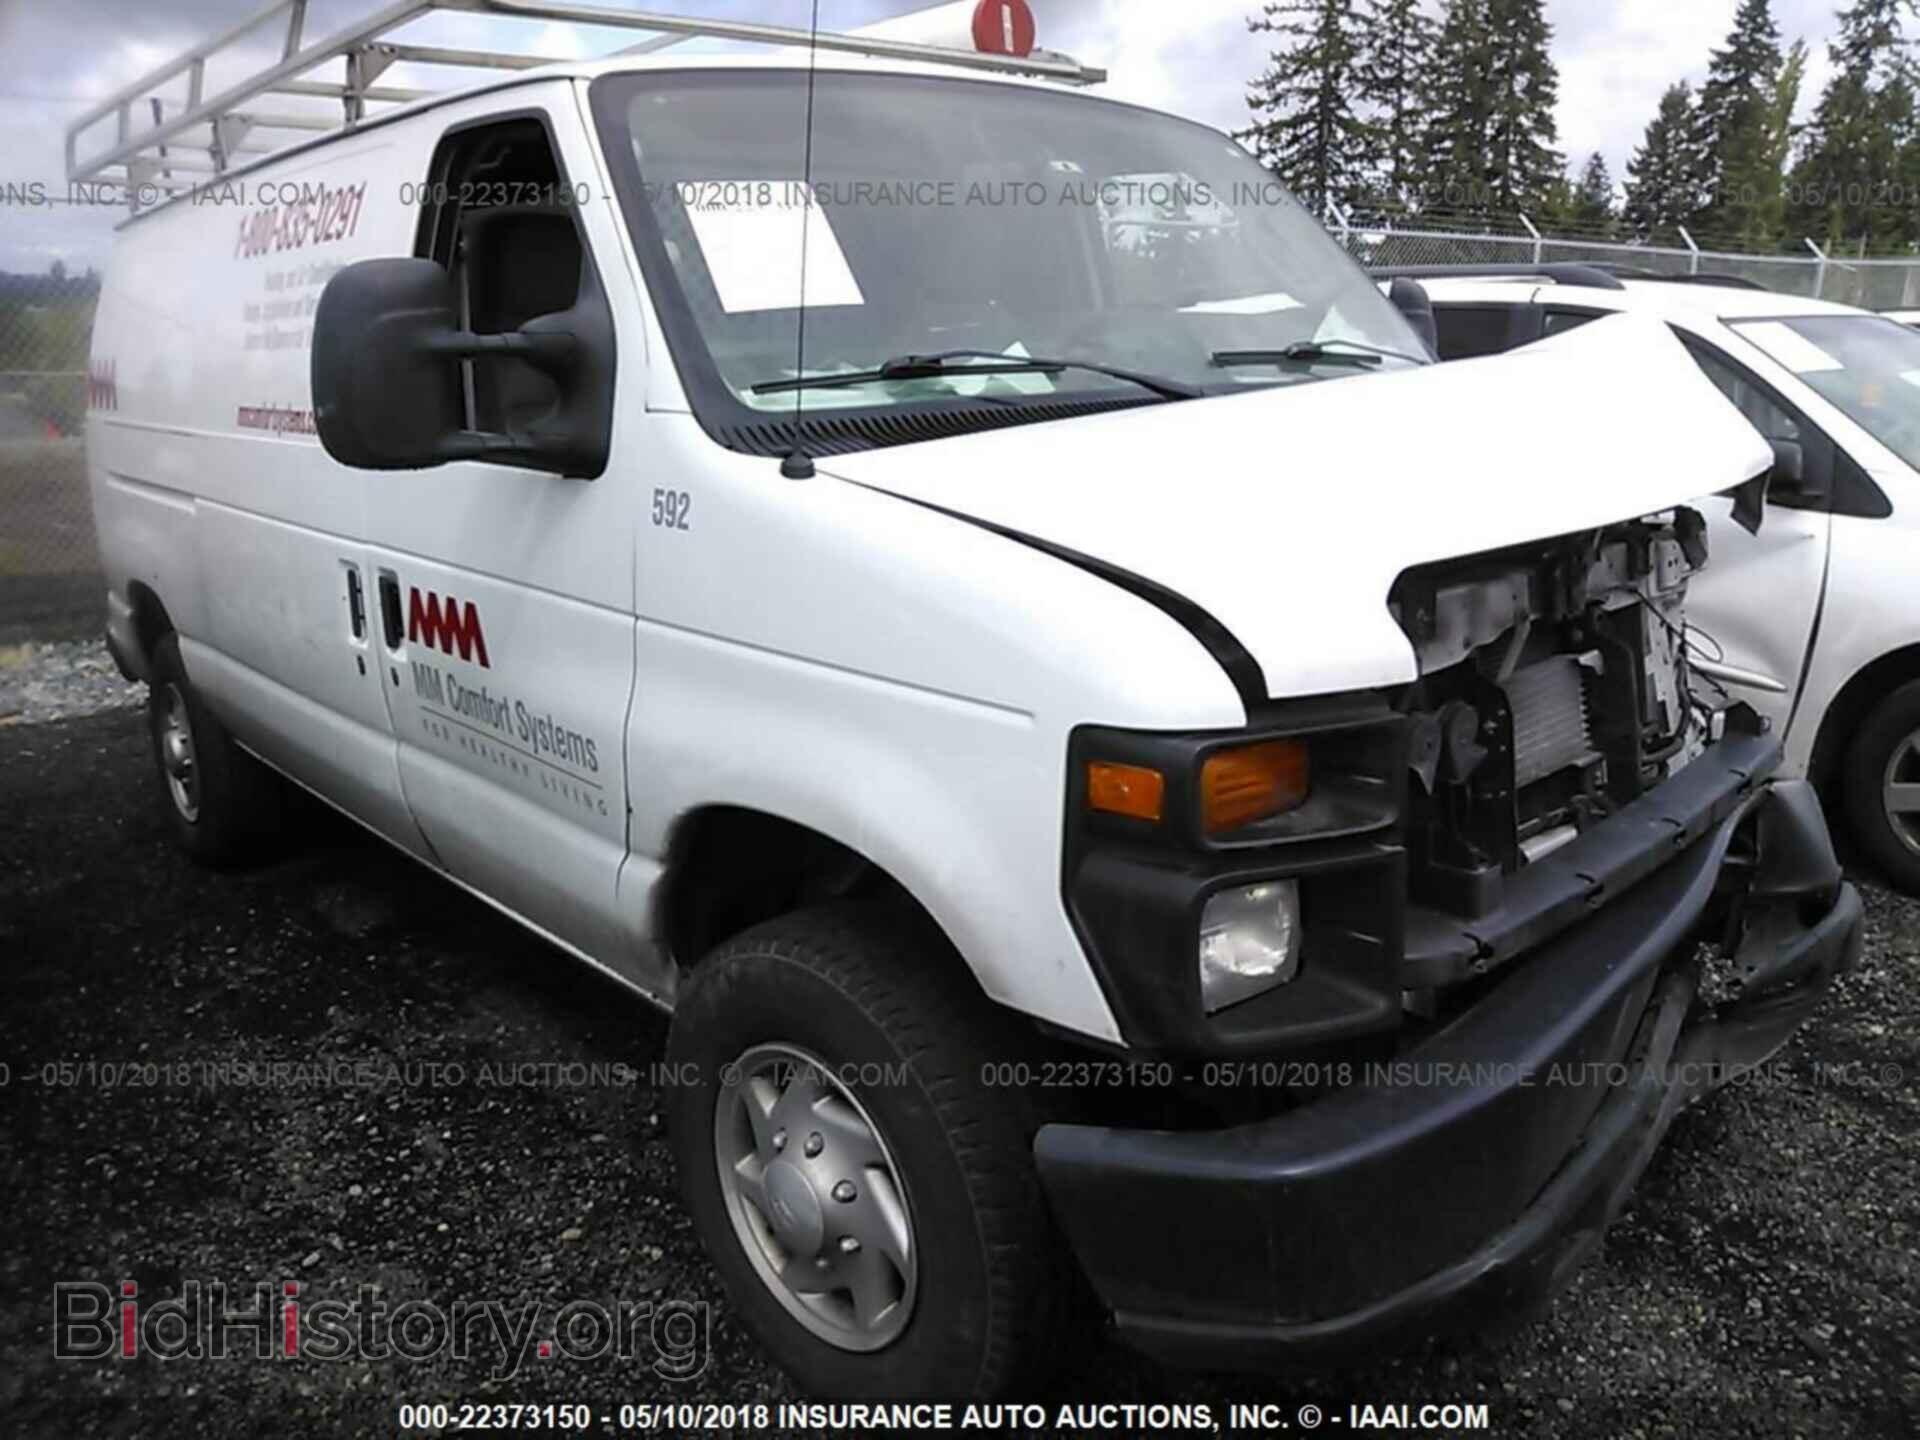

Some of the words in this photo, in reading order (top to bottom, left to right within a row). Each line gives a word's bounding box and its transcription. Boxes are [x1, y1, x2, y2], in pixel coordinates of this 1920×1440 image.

[652, 488, 690, 530] 592
[411, 661, 444, 706] MM
[447, 674, 513, 735] Comfort
[515, 701, 599, 772] Systems
